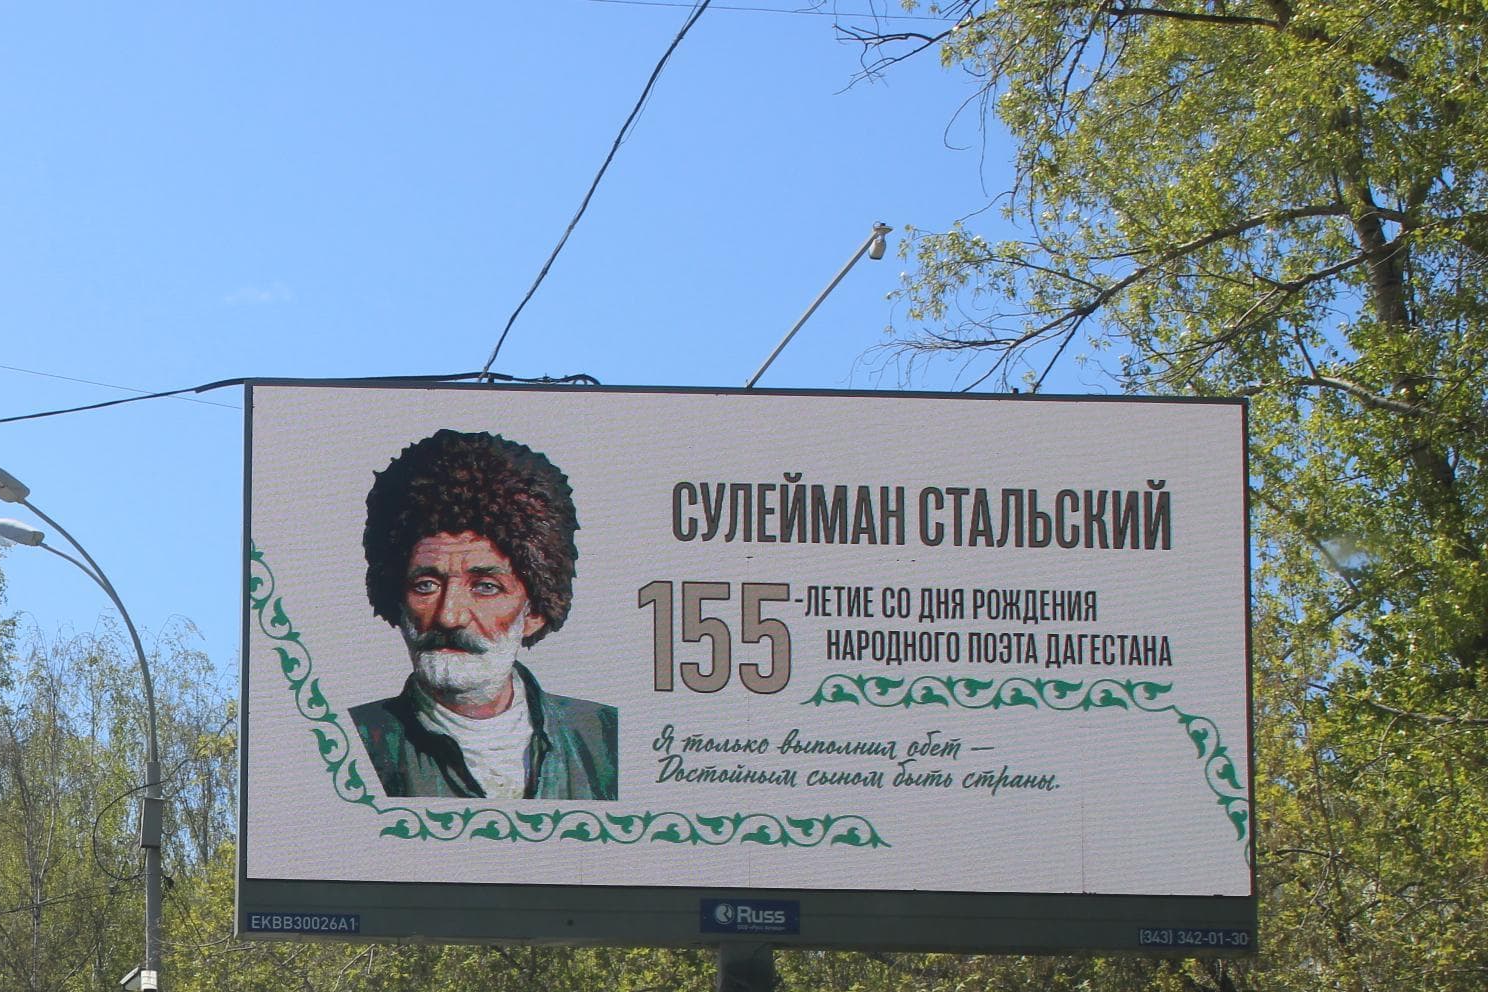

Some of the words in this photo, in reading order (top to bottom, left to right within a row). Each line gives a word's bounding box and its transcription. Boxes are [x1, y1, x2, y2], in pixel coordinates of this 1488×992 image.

[673, 472, 905, 545] СУЛЕЙМАН
[919, 480, 1171, 550] СТАЛЬСКИЙ
[882, 587, 910, 618] СО
[919, 588, 964, 623] ДНЯ
[973, 589, 1097, 624] РОЖДЕНИЯ
[827, 630, 960, 665] НАРОДНОГО
[968, 632, 1038, 664] ПОЭТА
[1045, 634, 1172, 668] ДАГЕСТАНА
[653, 724, 674, 754] Я
[682, 735, 769, 754] только
[777, 729, 897, 760] выполнил
[907, 730, 961, 759] обет
[656, 756, 797, 787] Достойным
[807, 770, 884, 788] сыном
[890, 759, 956, 788] быть
[962, 766, 1060, 796] страны.
[736, 905, 786, 924] Russ
[1139, 929, 1173, 945] (343)
[1177, 930, 1249, 945] 342-01-30
